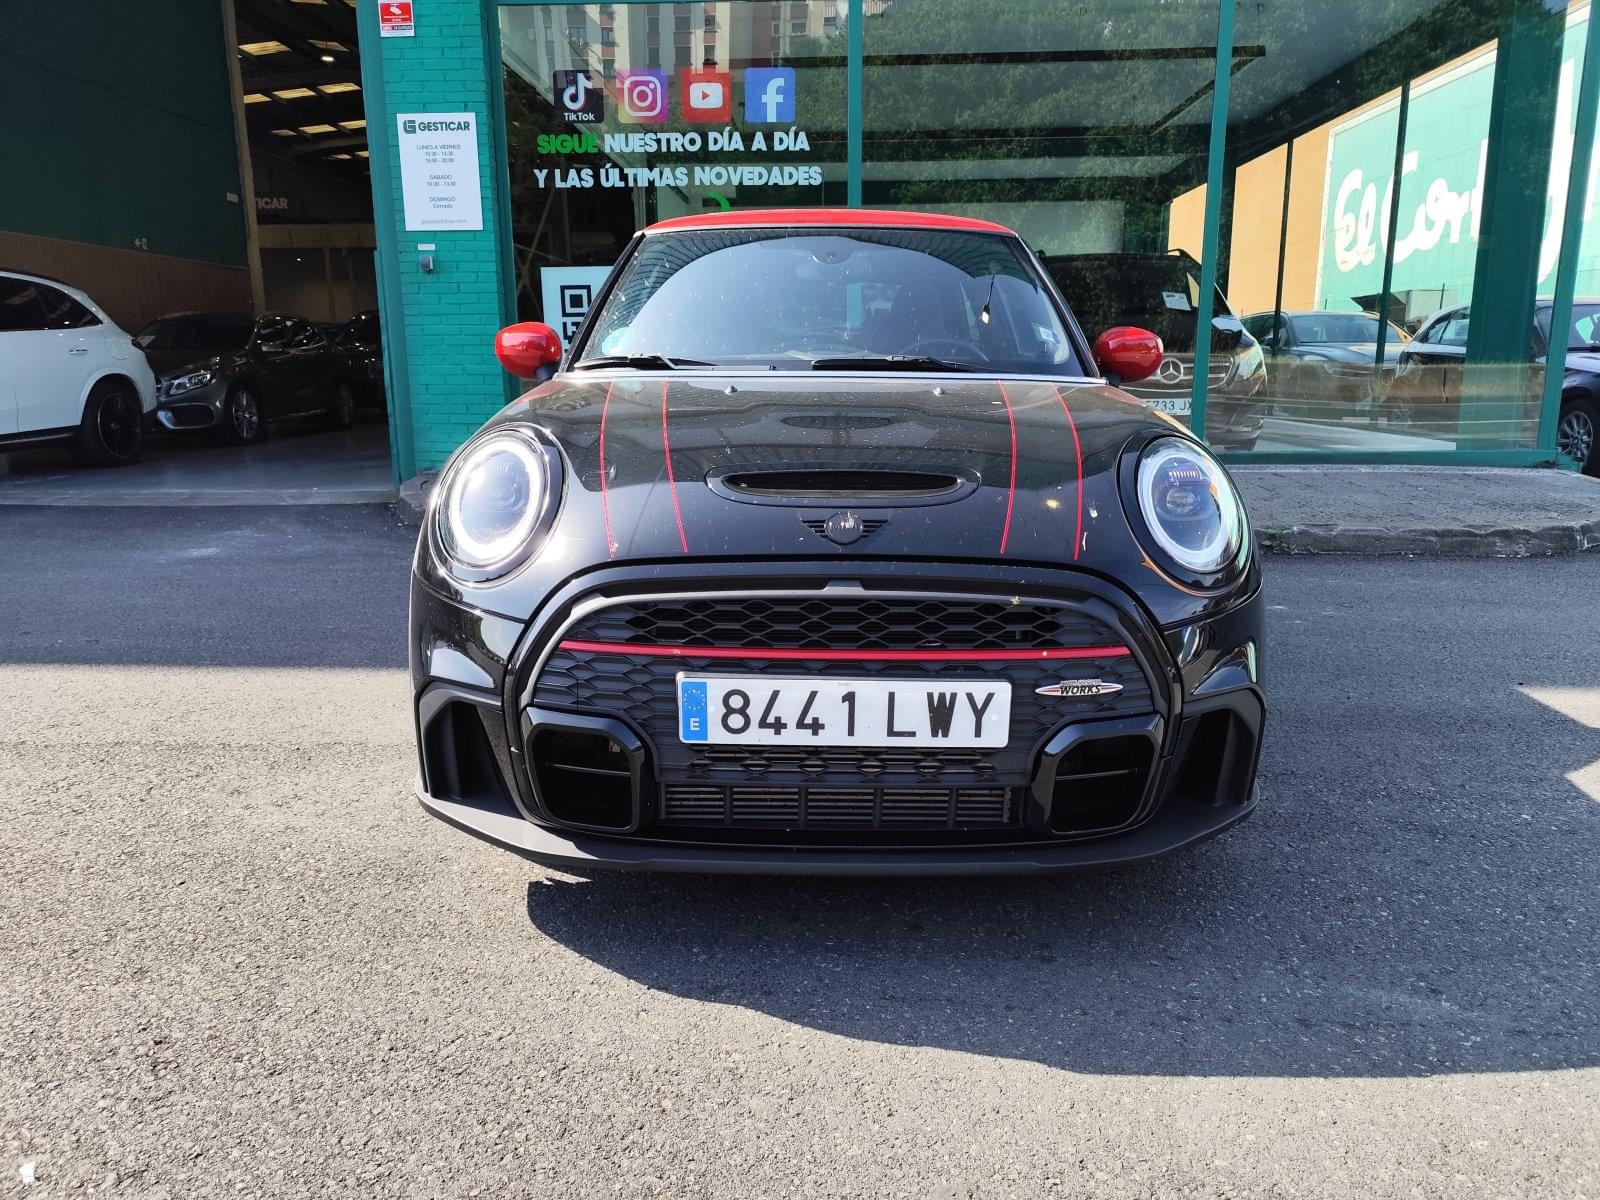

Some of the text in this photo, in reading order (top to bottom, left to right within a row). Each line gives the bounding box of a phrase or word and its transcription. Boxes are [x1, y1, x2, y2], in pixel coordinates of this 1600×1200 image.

[564, 112, 595, 121] TikTok
[418, 121, 470, 132] GESTICAR
[537, 126, 811, 154] SIGUE NUESTRO DÍA A DÍA
[533, 163, 822, 188] Y LAS ÚLTIMAS NOVEDADES
[1334, 169, 1376, 272] El
[1146, 400, 1175, 411] 733
[1060, 684, 1101, 695] WORKS
[690, 688, 996, 739] E 8441 LWY
